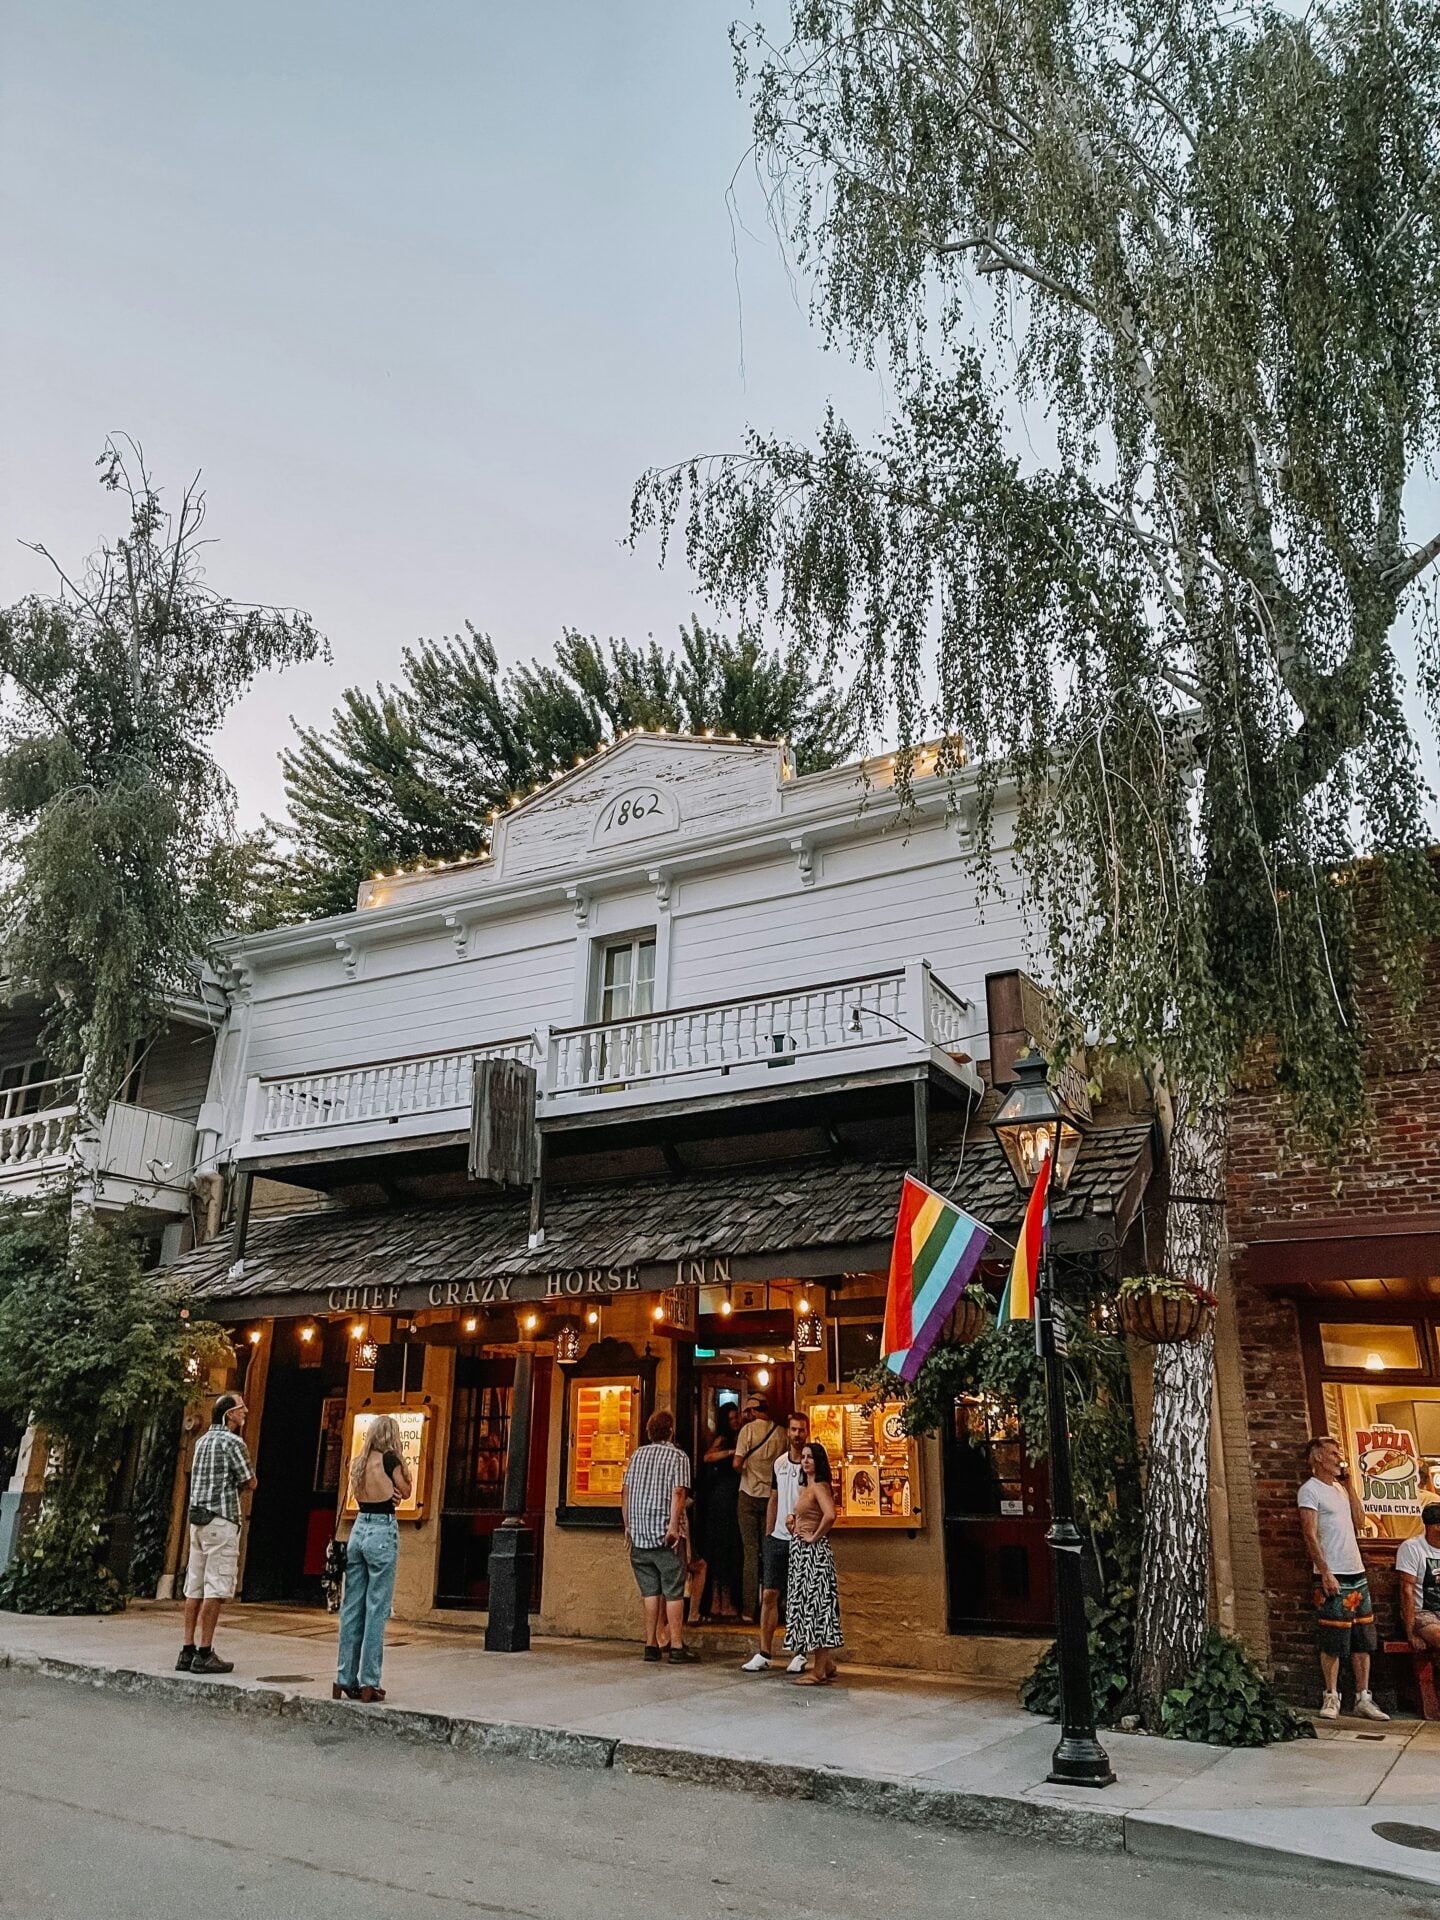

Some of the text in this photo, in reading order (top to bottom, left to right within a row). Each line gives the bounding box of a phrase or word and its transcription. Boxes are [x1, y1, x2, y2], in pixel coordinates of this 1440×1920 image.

[604, 793, 664, 833] 1862
[328, 1287, 400, 1310] CHIEF
[428, 1277, 514, 1306] CRAZY
[546, 1267, 640, 1296] HORSE
[675, 1257, 732, 1285] INN
[1356, 1431, 1415, 1457] PIZZA
[1362, 1474, 1418, 1501] JOINT
[1364, 1504, 1393, 1513] NEVADA
